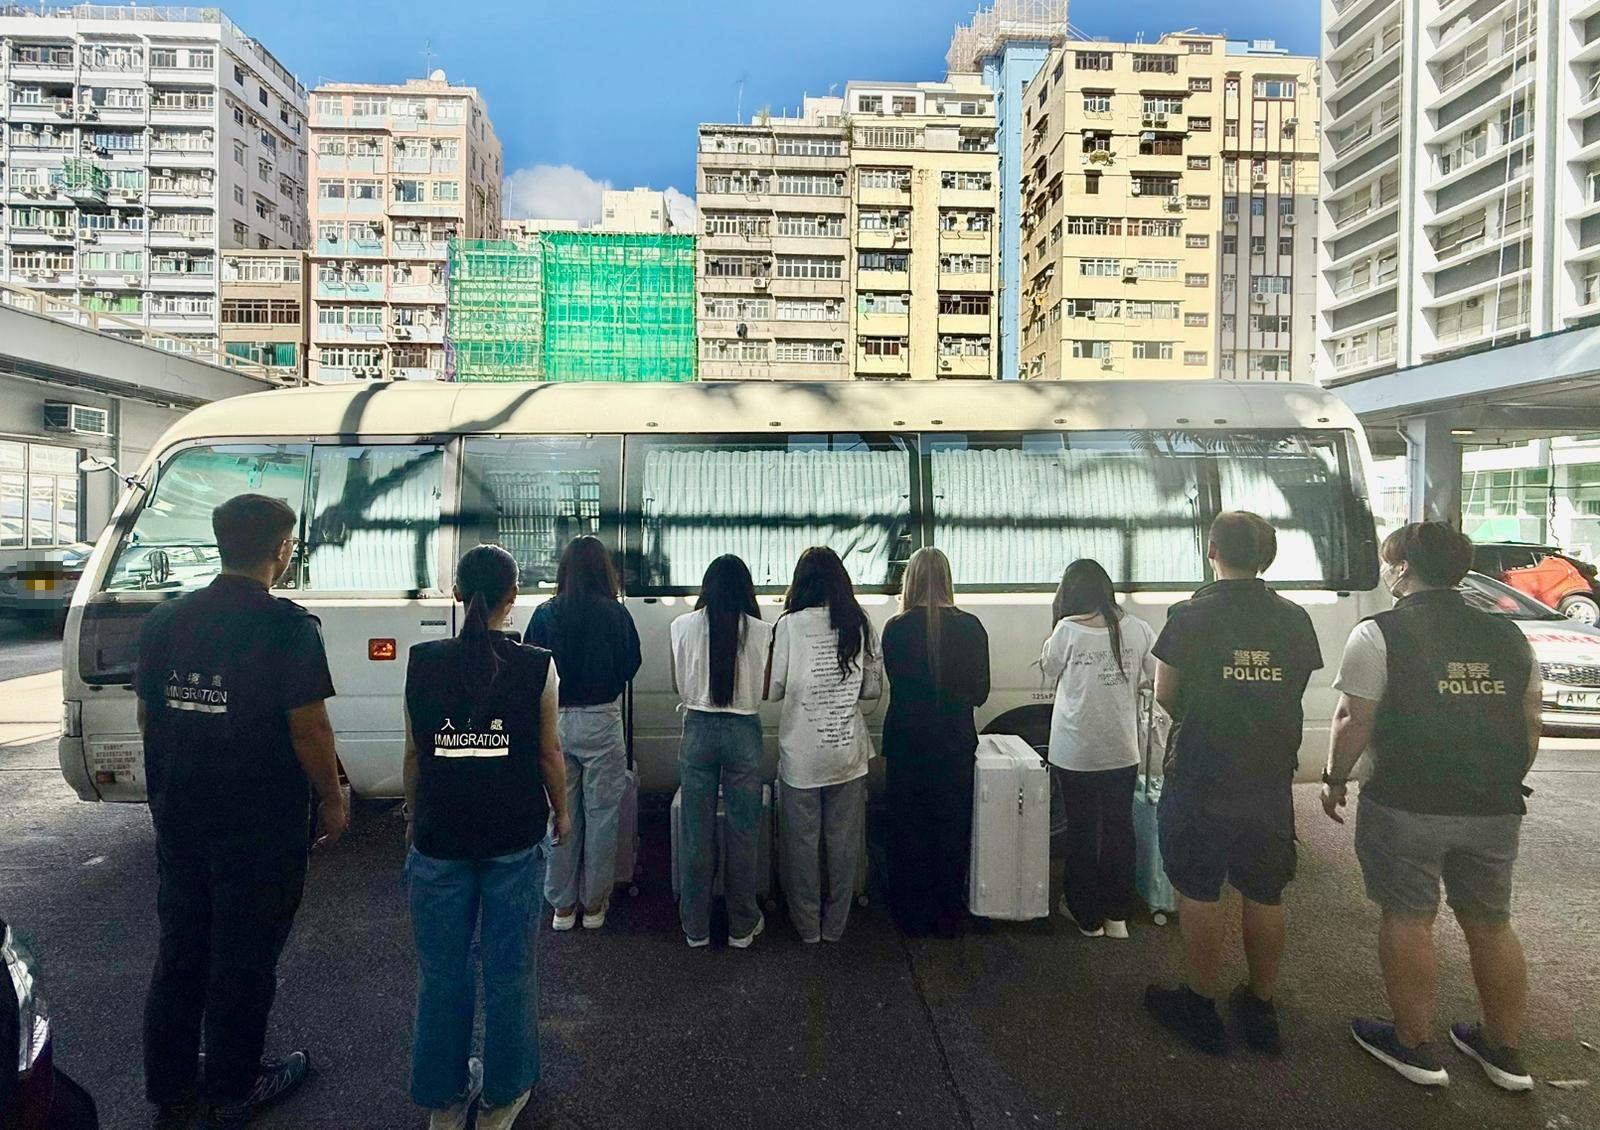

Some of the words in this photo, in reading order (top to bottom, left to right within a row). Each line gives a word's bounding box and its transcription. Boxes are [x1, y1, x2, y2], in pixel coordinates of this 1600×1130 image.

[1232, 649, 1271, 666] 警察
[1222, 665, 1283, 681] POLICE
[1447, 661, 1490, 679] 警察
[1438, 679, 1506, 695] POLICE
[1566, 692, 1586, 704] AM
[440, 717, 504, 731] 入處
[434, 733, 510, 747] IMMIGRATION
